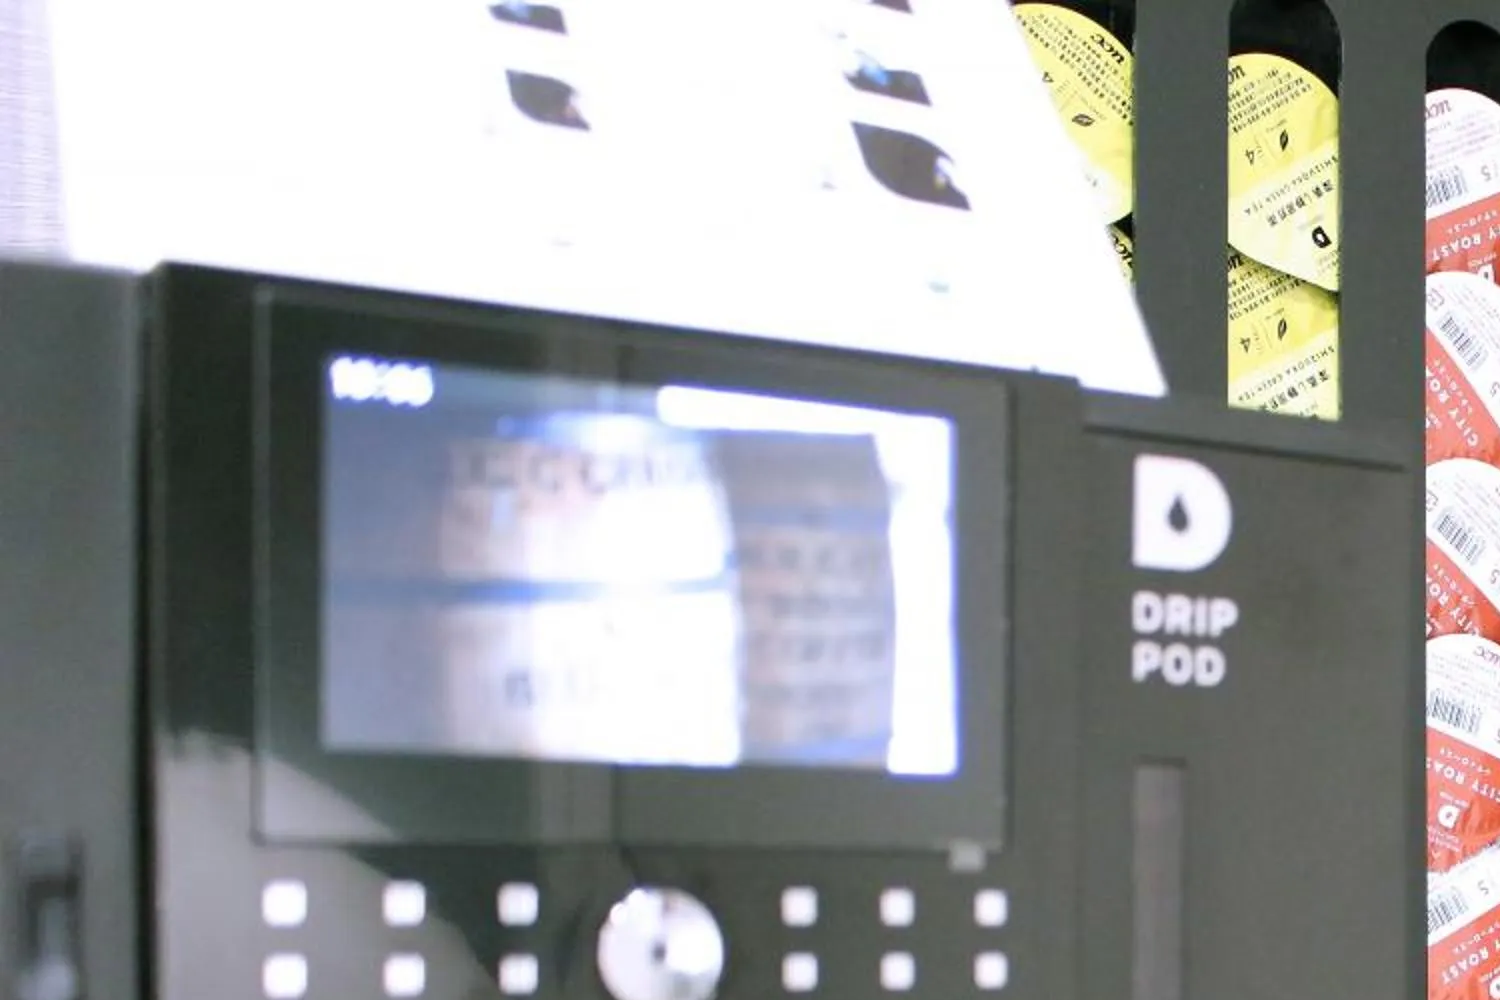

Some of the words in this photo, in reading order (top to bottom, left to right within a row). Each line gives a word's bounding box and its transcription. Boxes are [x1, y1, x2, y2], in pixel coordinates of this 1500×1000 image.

[1432, 233, 1482, 262] ROAST
[1448, 409, 1479, 447] CITY
[1131, 590, 1239, 637] DRIP
[1131, 640, 1226, 687] POD
[1442, 947, 1489, 985] ROAST
